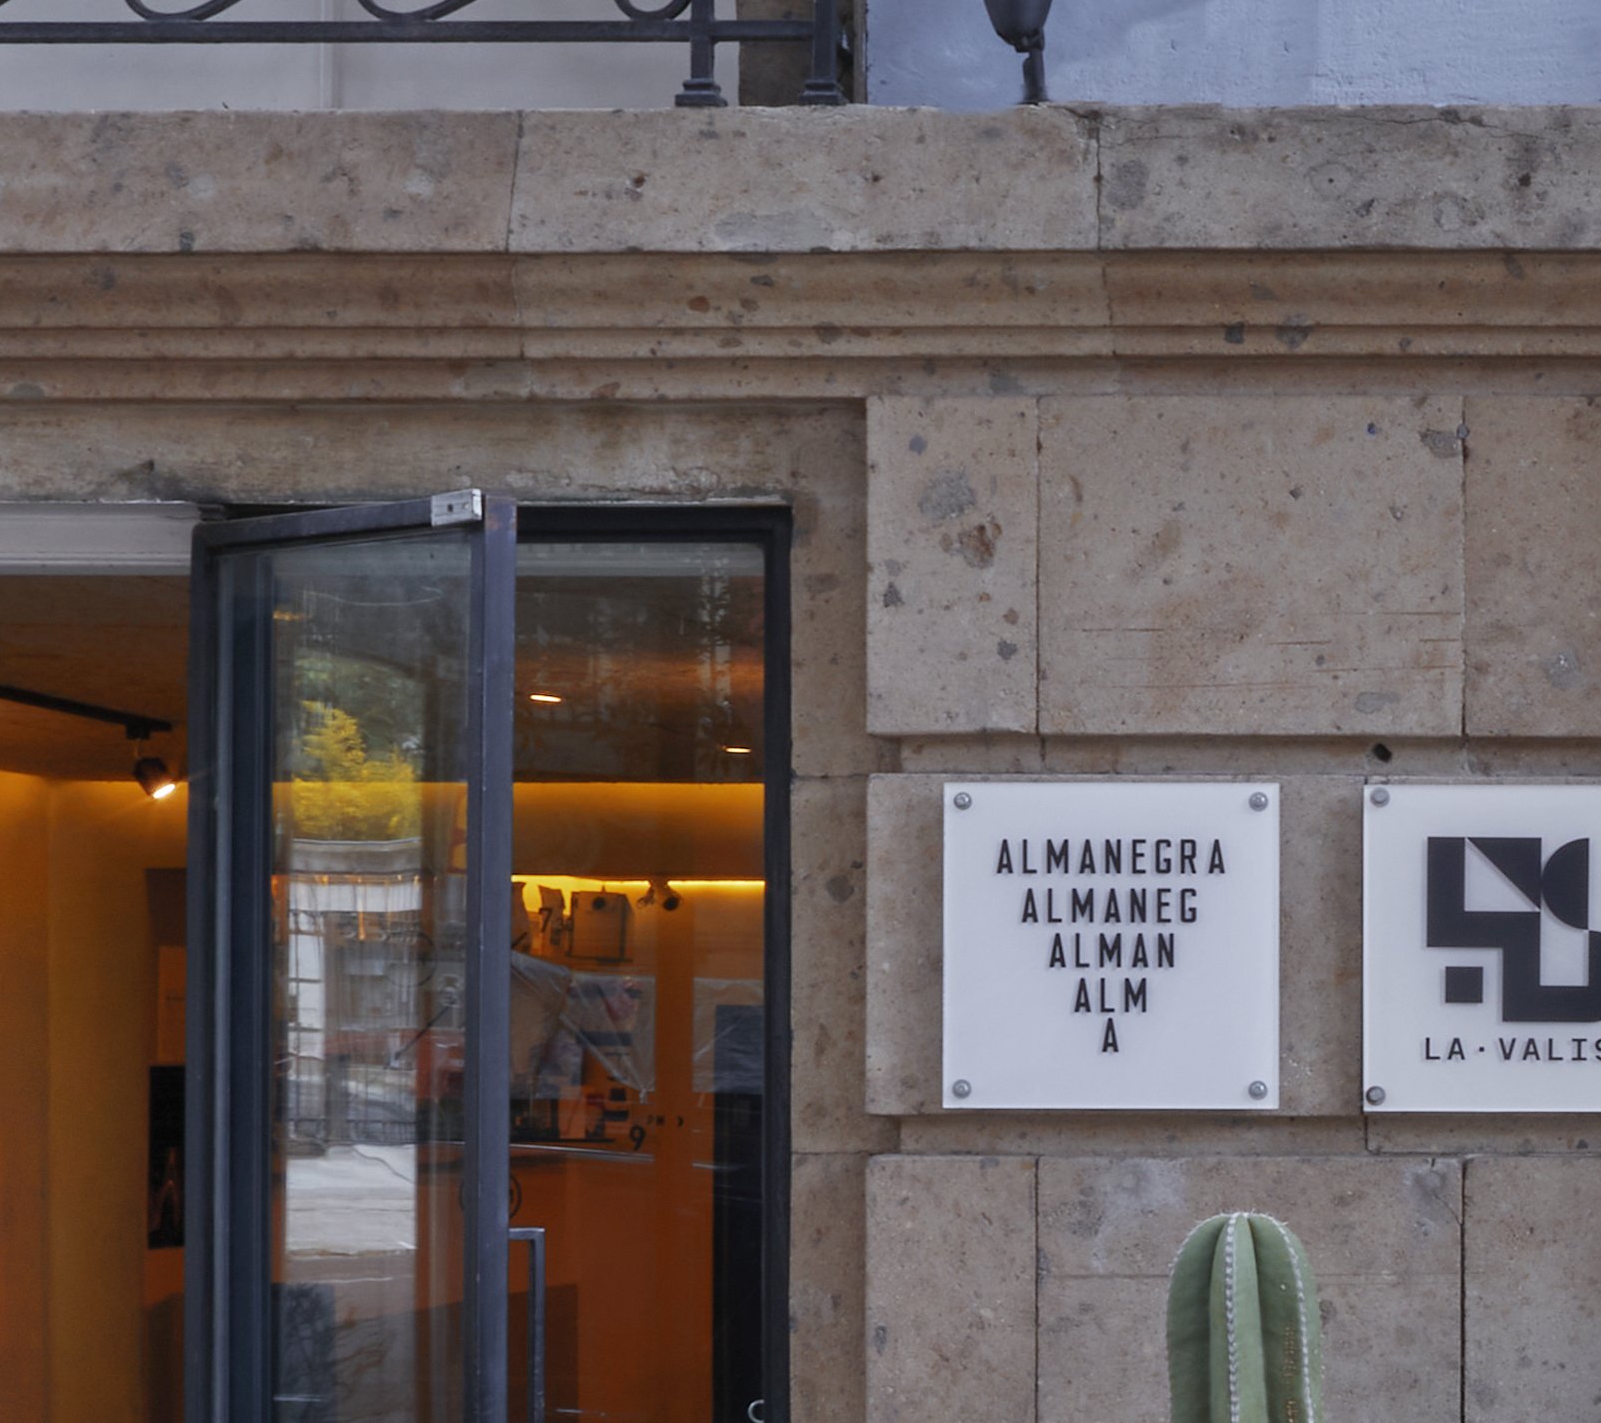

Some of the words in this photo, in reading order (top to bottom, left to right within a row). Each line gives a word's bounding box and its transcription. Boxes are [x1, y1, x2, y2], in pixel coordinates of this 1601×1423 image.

[996, 838, 1227, 876] ALMANEGRA
[1021, 887, 1198, 925] ALMANEG
[1048, 932, 1176, 970] ALMAN
[1073, 977, 1148, 1014] ALM
[1101, 1017, 1120, 1054] A
